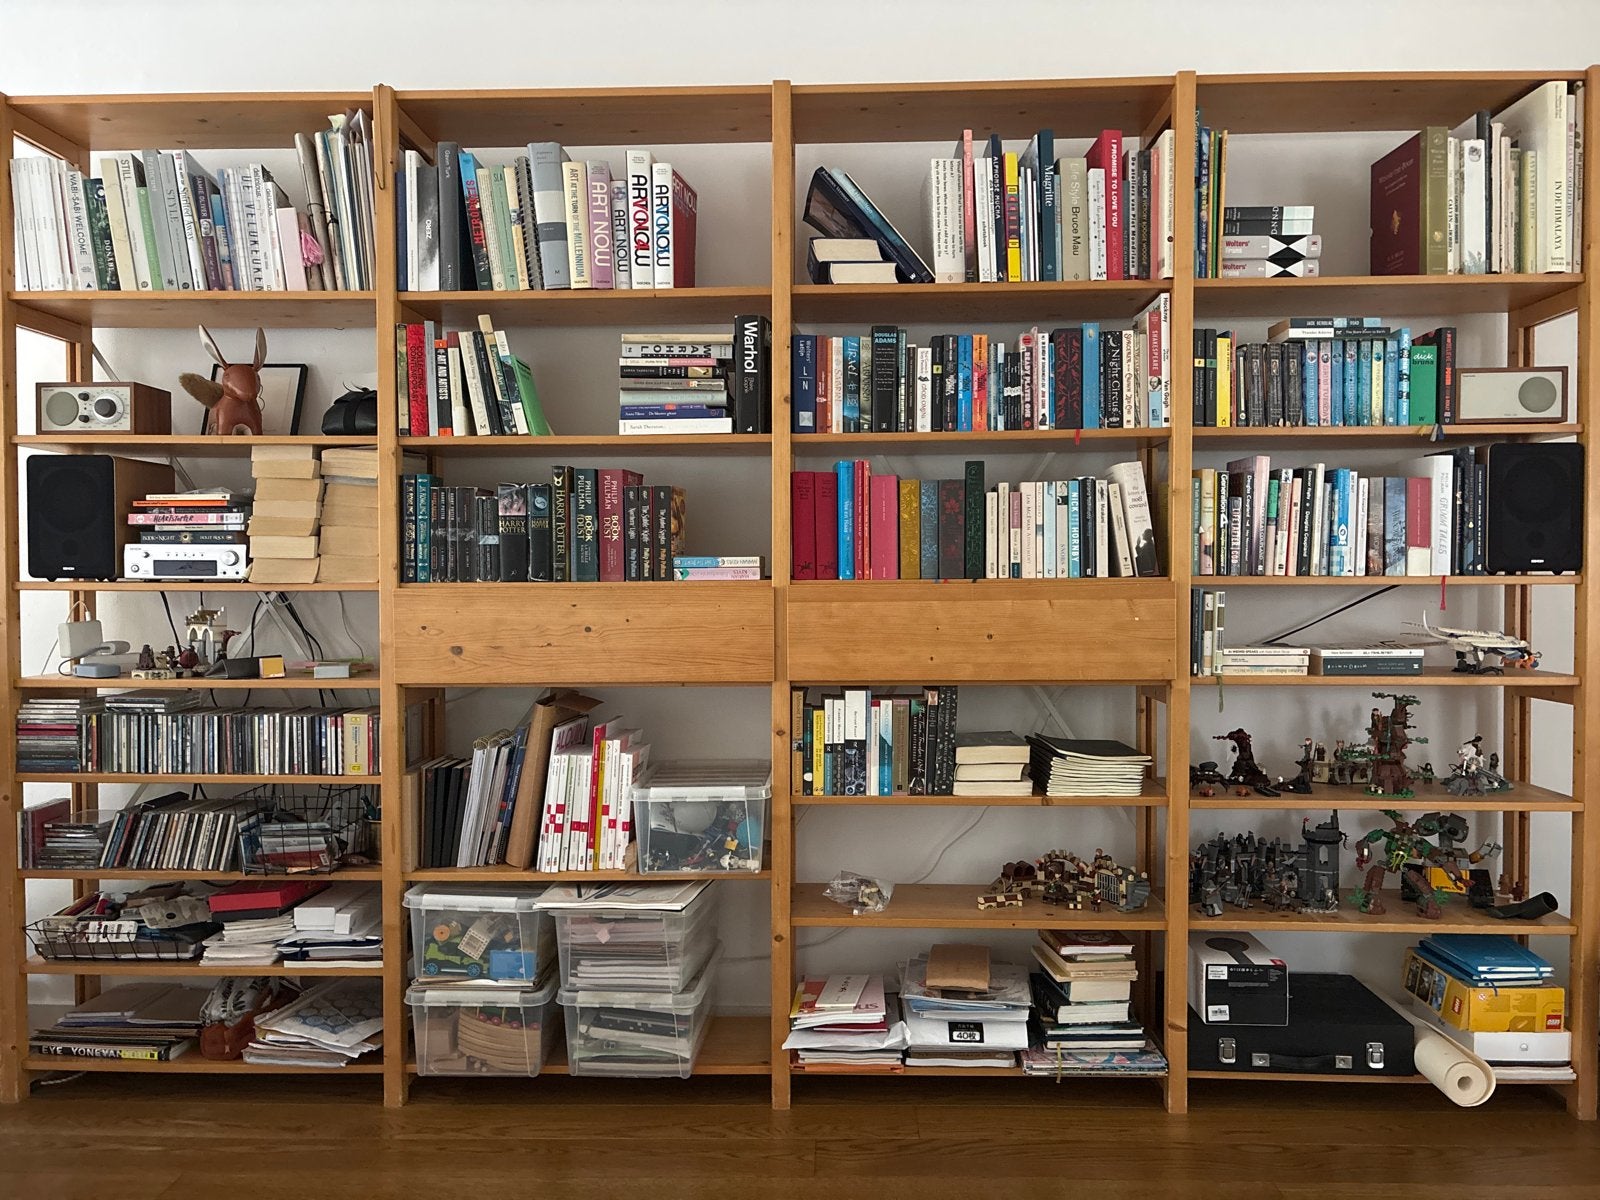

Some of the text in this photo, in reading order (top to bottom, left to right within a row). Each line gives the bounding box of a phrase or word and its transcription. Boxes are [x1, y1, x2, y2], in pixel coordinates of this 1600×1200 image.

[121, 158, 132, 182] STILL
[146, 156, 158, 193] Brancusi
[570, 168, 579, 182] ART
[1130, 157, 1136, 166] De
[196, 176, 208, 217] JAMIE OLIVER
[1043, 164, 1054, 207] Magritte
[1112, 179, 1117, 190] TO
[69, 173, 87, 256] WABI-SABI WELCOME
[166, 189, 179, 224] STYLE
[179, 187, 192, 216] Spirited
[465, 179, 483, 245] METROPOLIS
[571, 199, 579, 214] TURN
[1068, 163, 1081, 256] Life Style Bruce Mau
[1554, 181, 1562, 250] IN DE HIMALAYA
[185, 219, 195, 242] Away
[592, 181, 610, 267] ART NOW
[573, 232, 584, 278] MILLENNIUM
[614, 209, 628, 272] ART NOW
[490, 347, 499, 370] Purposes
[743, 321, 758, 373] Warhol
[1413, 351, 1434, 360] dick
[410, 345, 418, 402] CONTEMPORARY
[416, 345, 424, 389] COLLECTING
[437, 354, 448, 400] ART AND ARTISTS
[1109, 348, 1120, 412] Night Circus
[604, 475, 612, 509] PULLMAN
[152, 514, 195, 523] HEARTSTOPPER
[556, 489, 566, 556] HARRY POTTER
[584, 515, 593, 542] BOOK
[603, 517, 611, 540] DUST
[611, 515, 619, 542] BOOK
[629, 507, 637, 527] Northern
[641, 514, 649, 528] Subtle
[629, 548, 637, 560] Philip
[642, 547, 650, 559] Philip
[659, 548, 667, 560] Philip
[1071, 527, 1079, 562] HORNBY
[1302, 532, 1310, 557] Coupland
[1438, 529, 1448, 555] TALES
[795, 693, 803, 737] Almost French
[41, 1046, 64, 1055] EYE
